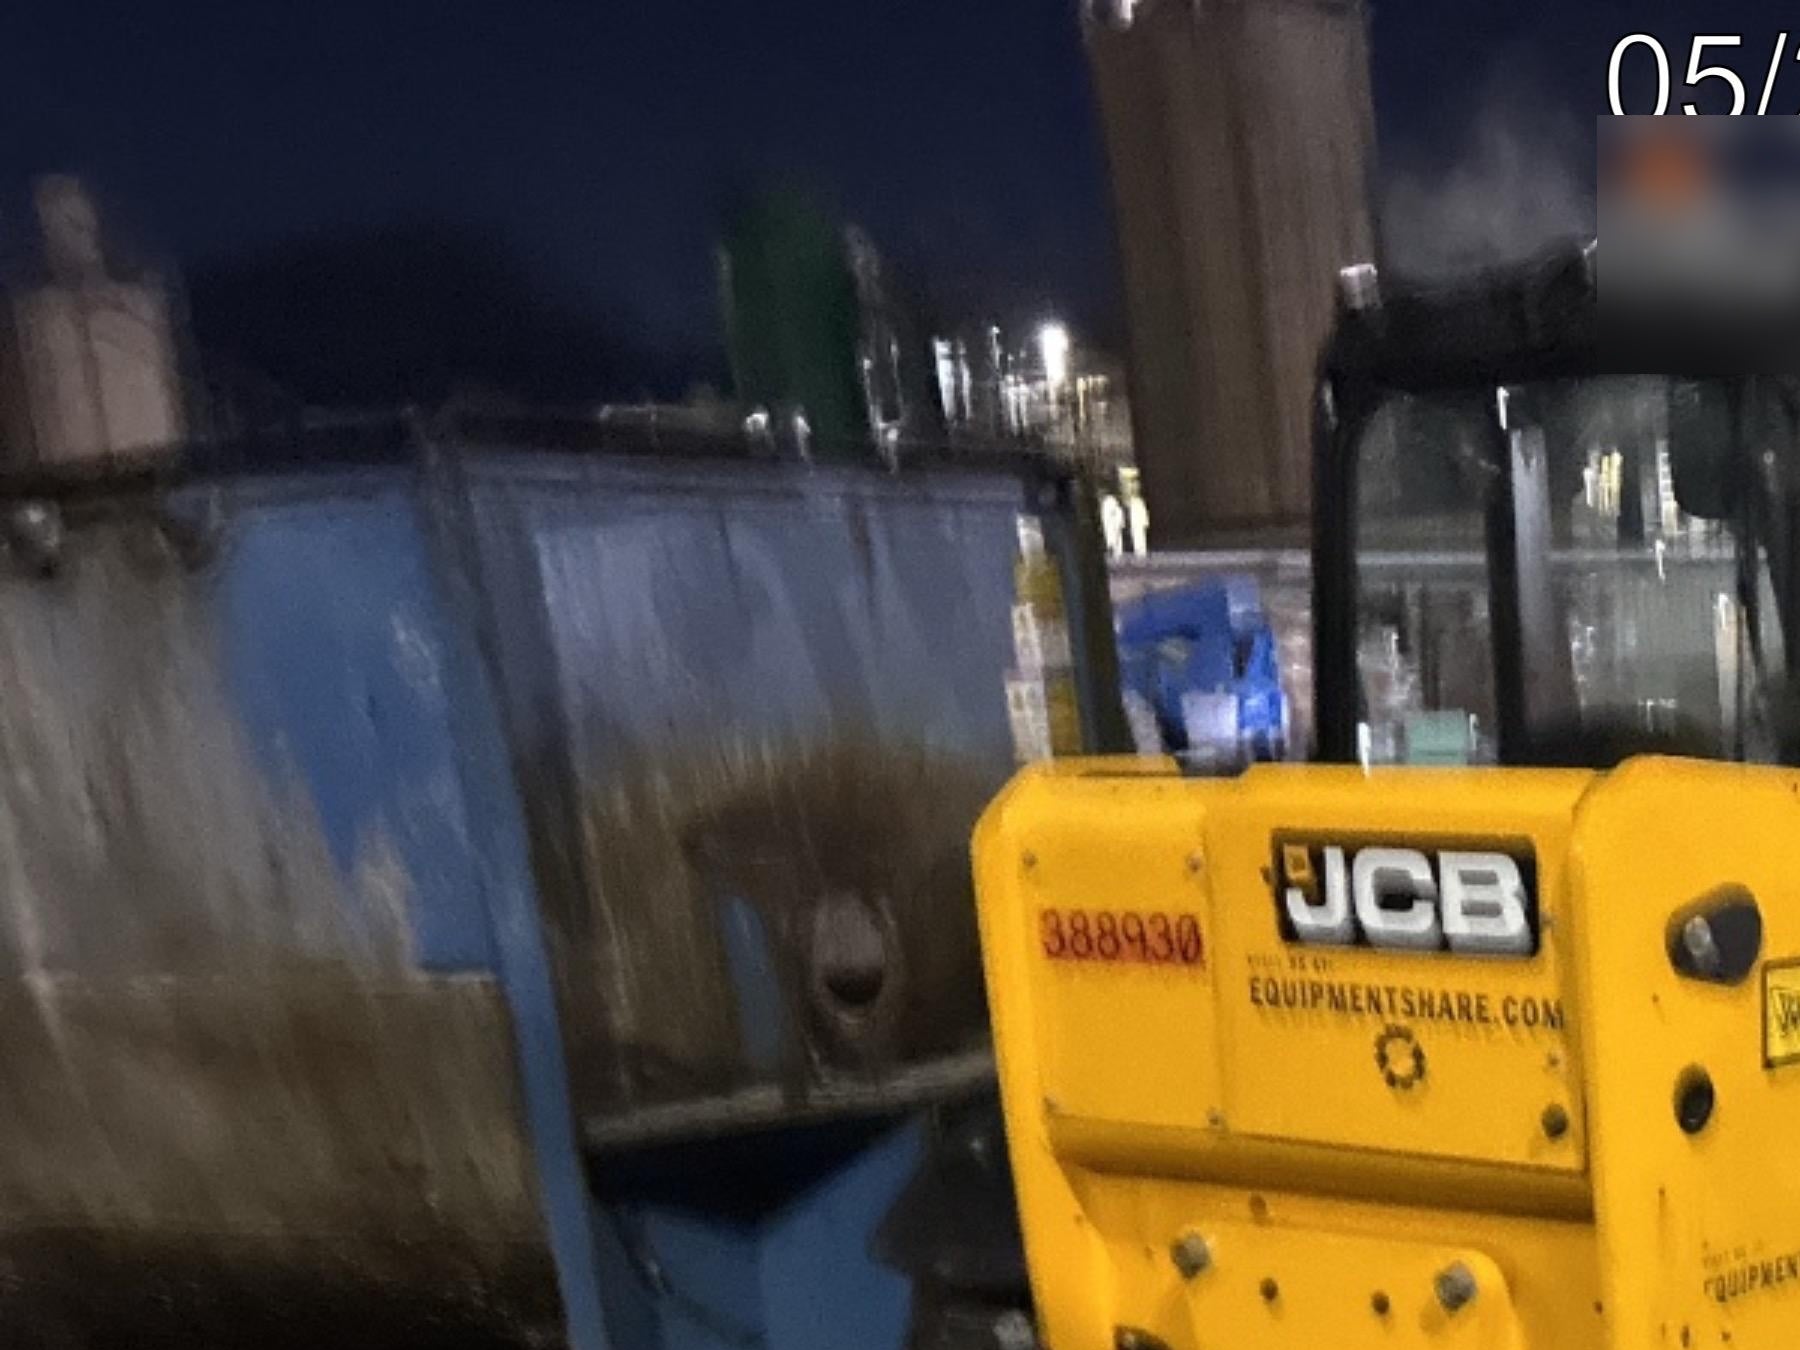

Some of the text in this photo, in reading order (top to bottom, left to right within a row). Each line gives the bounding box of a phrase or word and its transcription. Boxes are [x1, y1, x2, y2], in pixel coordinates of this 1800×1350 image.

[1284, 844, 1536, 956] JCB
[1041, 908, 1202, 963] 388930
[1249, 977, 1565, 1030] EQUIPMENTSHARE.COM
